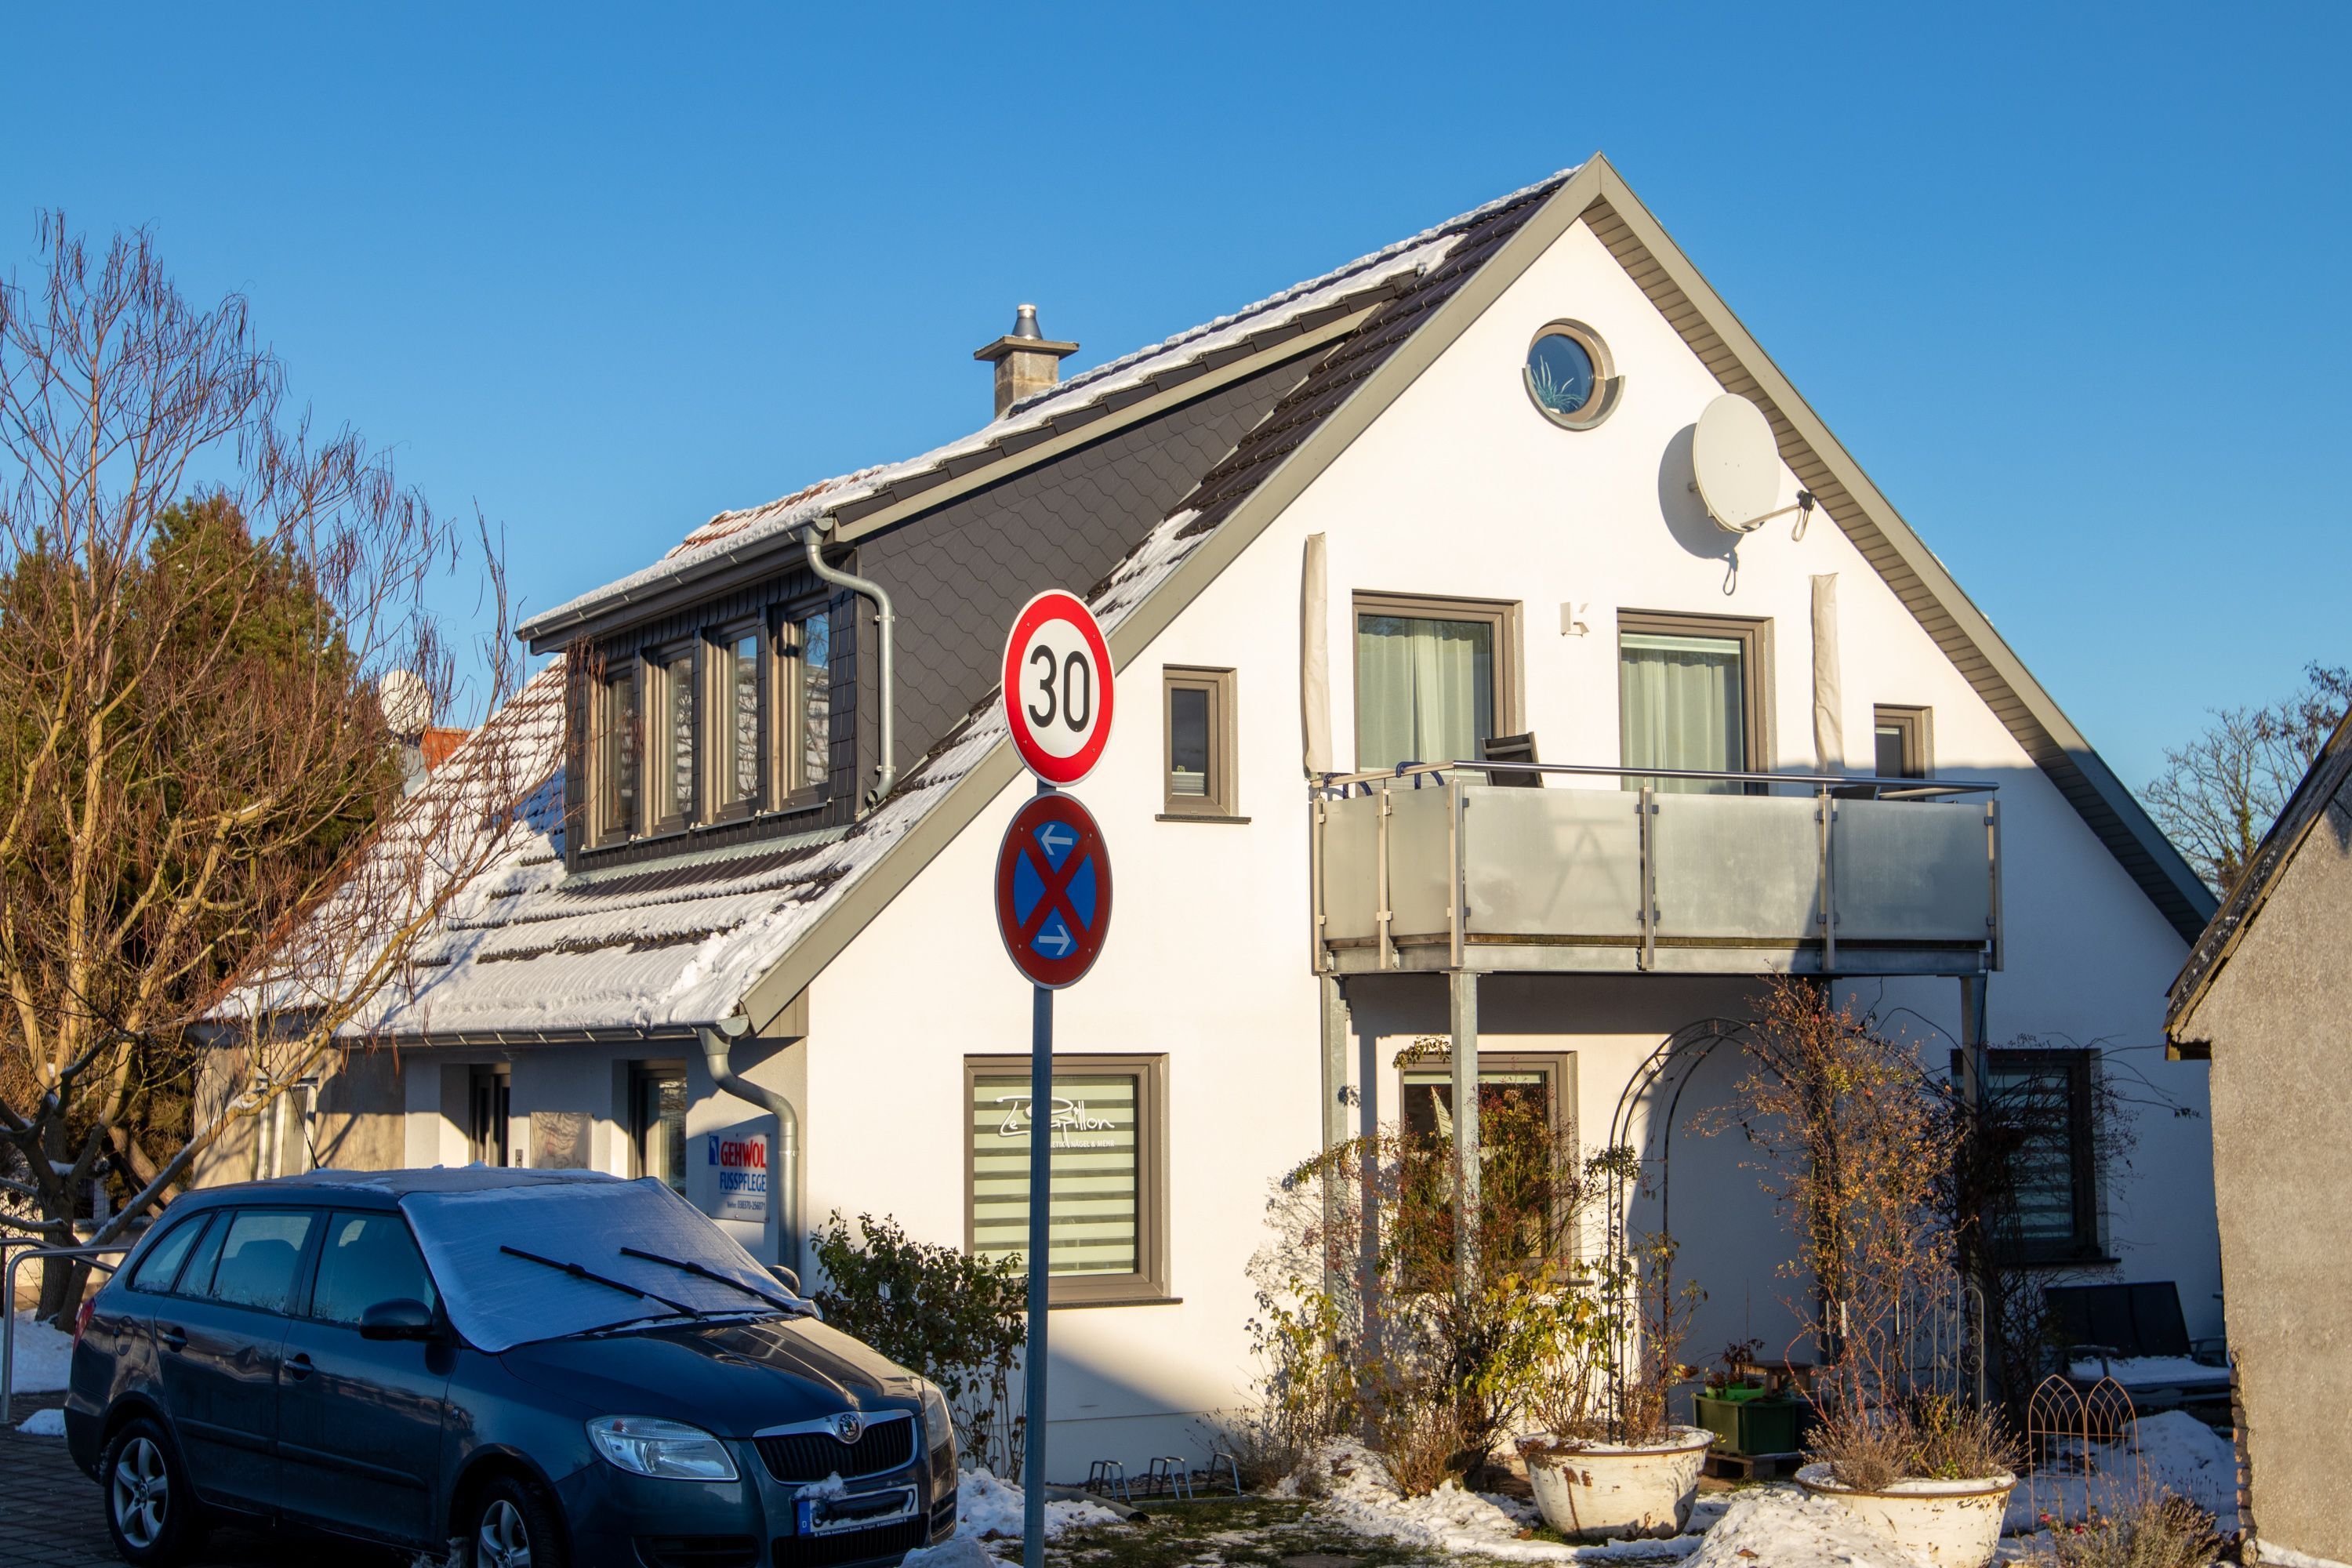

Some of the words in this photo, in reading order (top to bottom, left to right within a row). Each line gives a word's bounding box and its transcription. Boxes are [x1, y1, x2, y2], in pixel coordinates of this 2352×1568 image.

[1028, 644, 1091, 733] 30
[1000, 1100, 1031, 1136] Le
[720, 1139, 767, 1168] GEHWOL
[1071, 1139, 1090, 1148] NÄGEL
[720, 1171, 767, 1192] FUSSPFLEGE
[801, 1520, 808, 1529] D
